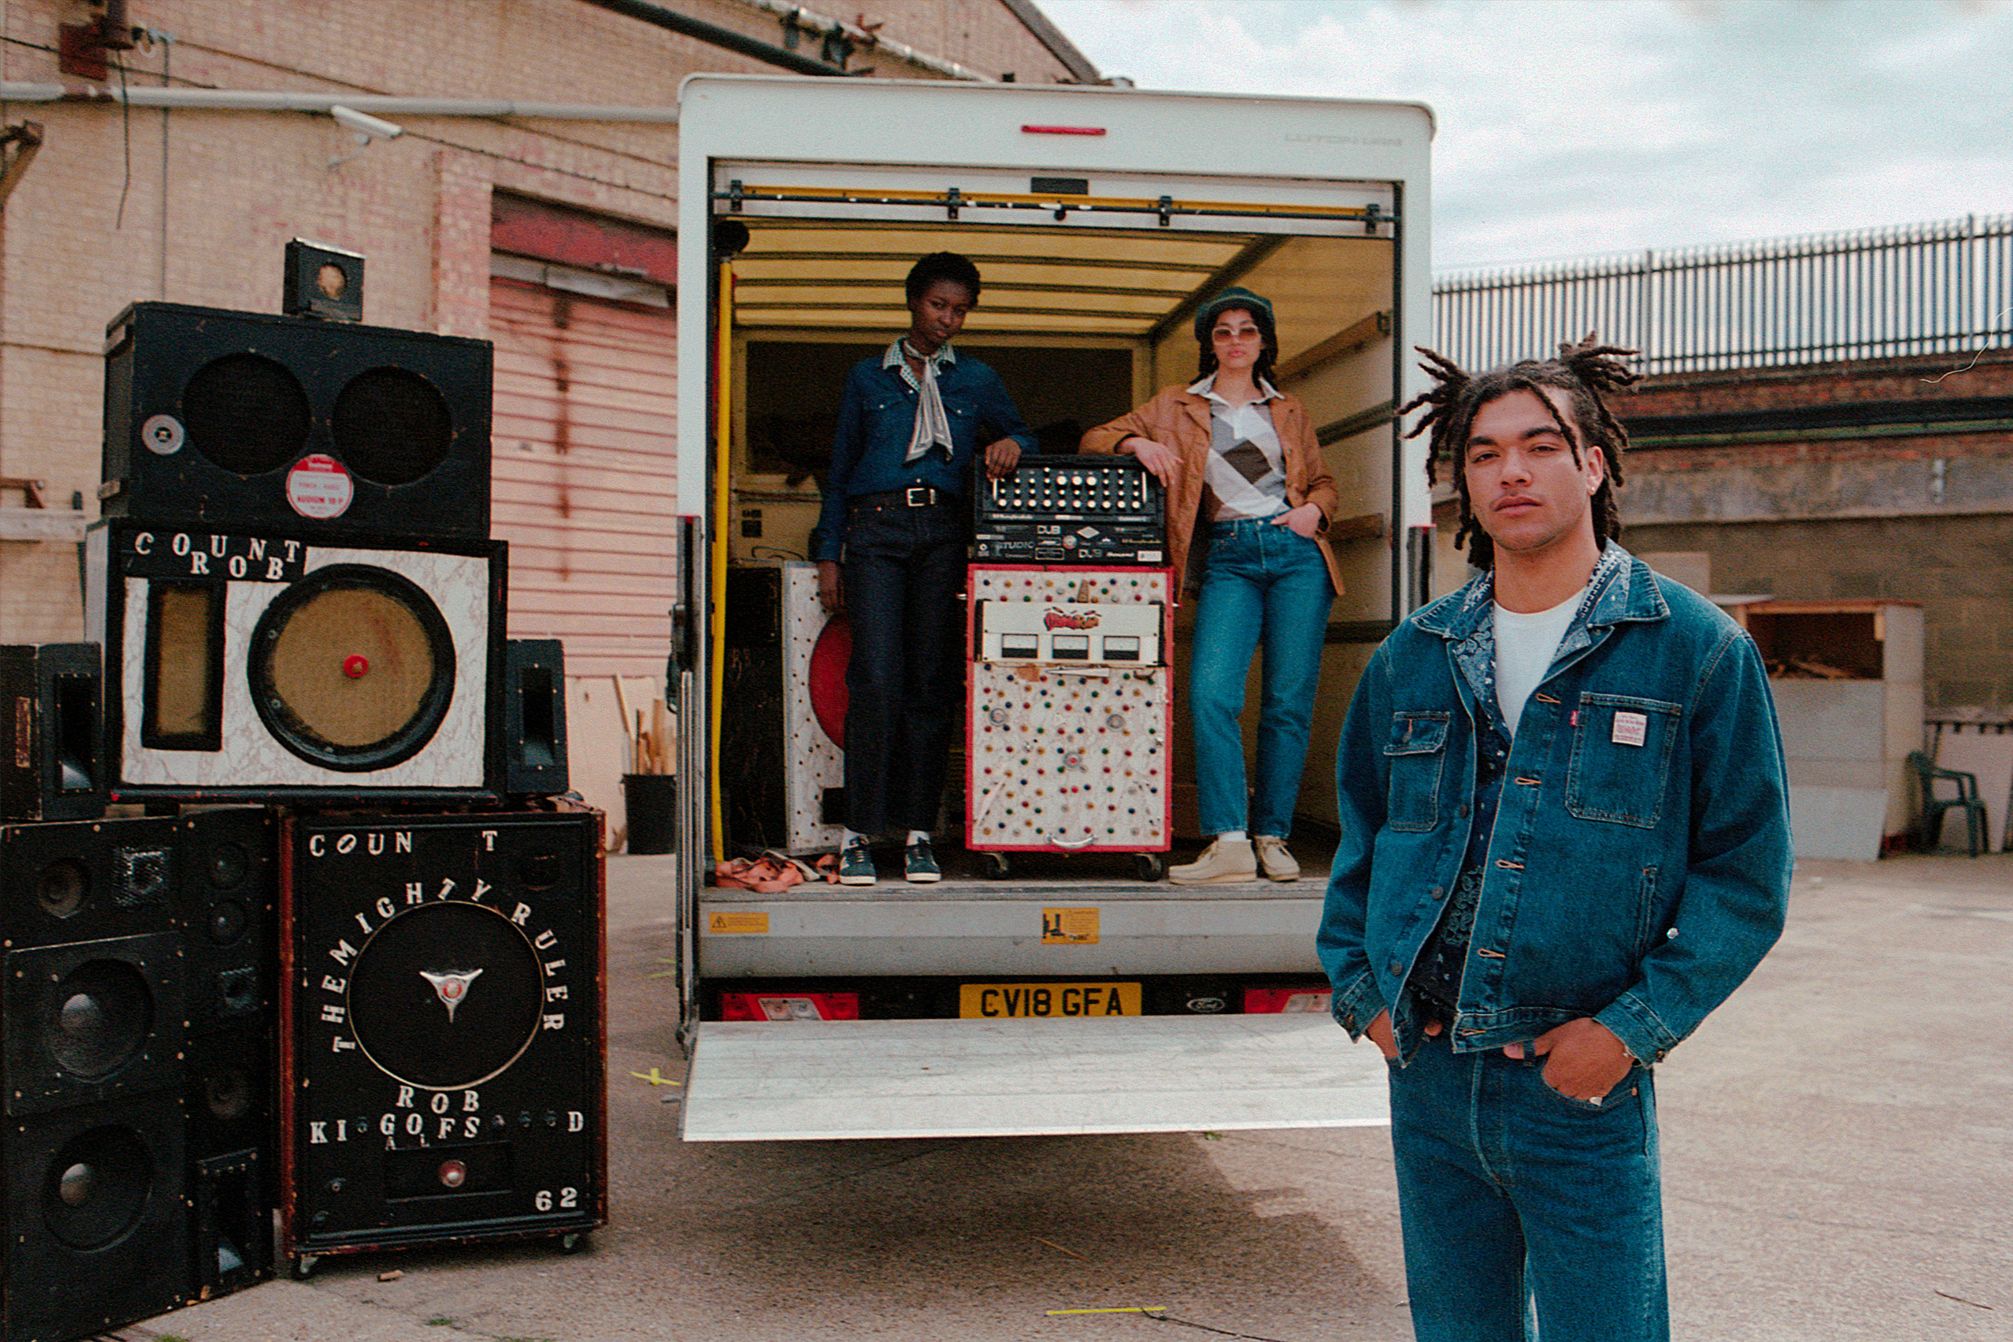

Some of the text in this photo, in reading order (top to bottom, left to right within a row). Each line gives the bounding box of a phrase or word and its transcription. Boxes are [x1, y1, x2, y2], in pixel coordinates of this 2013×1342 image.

[1037, 525, 1061, 535] DUB
[134, 531, 300, 563] COUNT
[190, 551, 284, 581] ROB
[309, 831, 498, 858] COUNT
[510, 902, 569, 1032] RULER
[981, 987, 1124, 1017] CV18 GFA
[396, 1086, 480, 1114] ROB
[535, 1186, 578, 1212] 62
